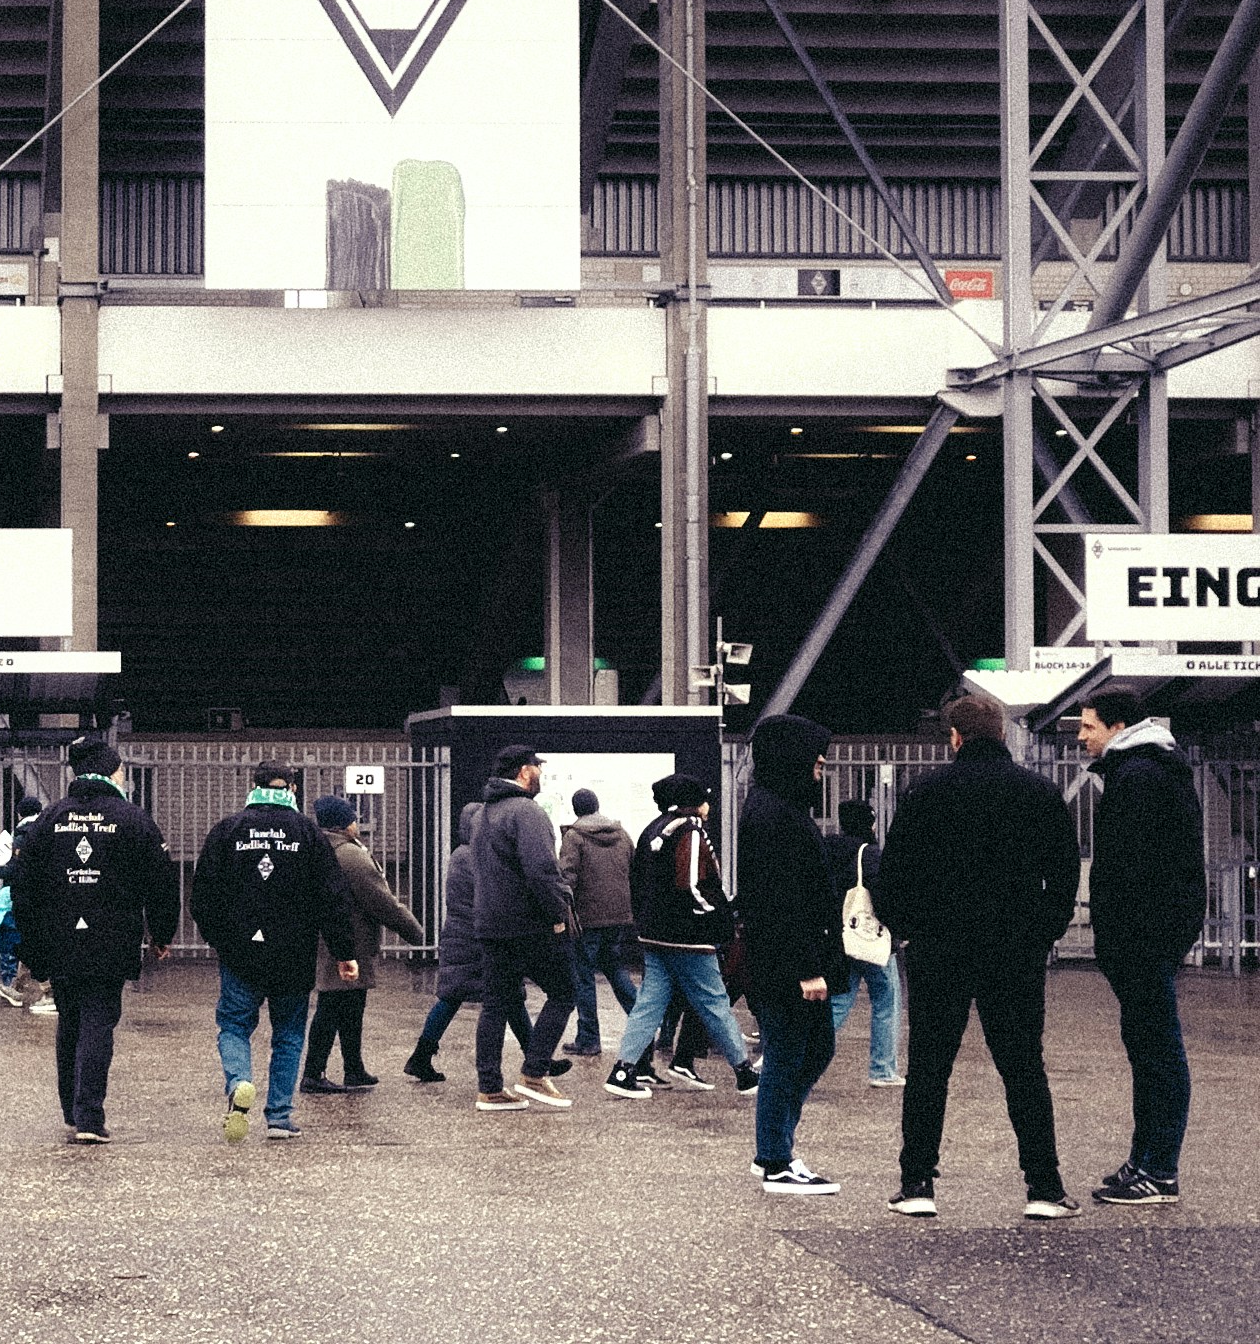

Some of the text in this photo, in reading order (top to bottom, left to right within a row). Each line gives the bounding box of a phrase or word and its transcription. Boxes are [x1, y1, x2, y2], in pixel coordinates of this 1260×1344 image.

[1128, 567, 1260, 607] EING
[1199, 661, 1230, 670] ALLE
[355, 774, 375, 785] 20
[54, 821, 118, 833] Endlich Treff
[249, 828, 287, 839] Fanclub
[235, 839, 301, 852] Endlich Treff
